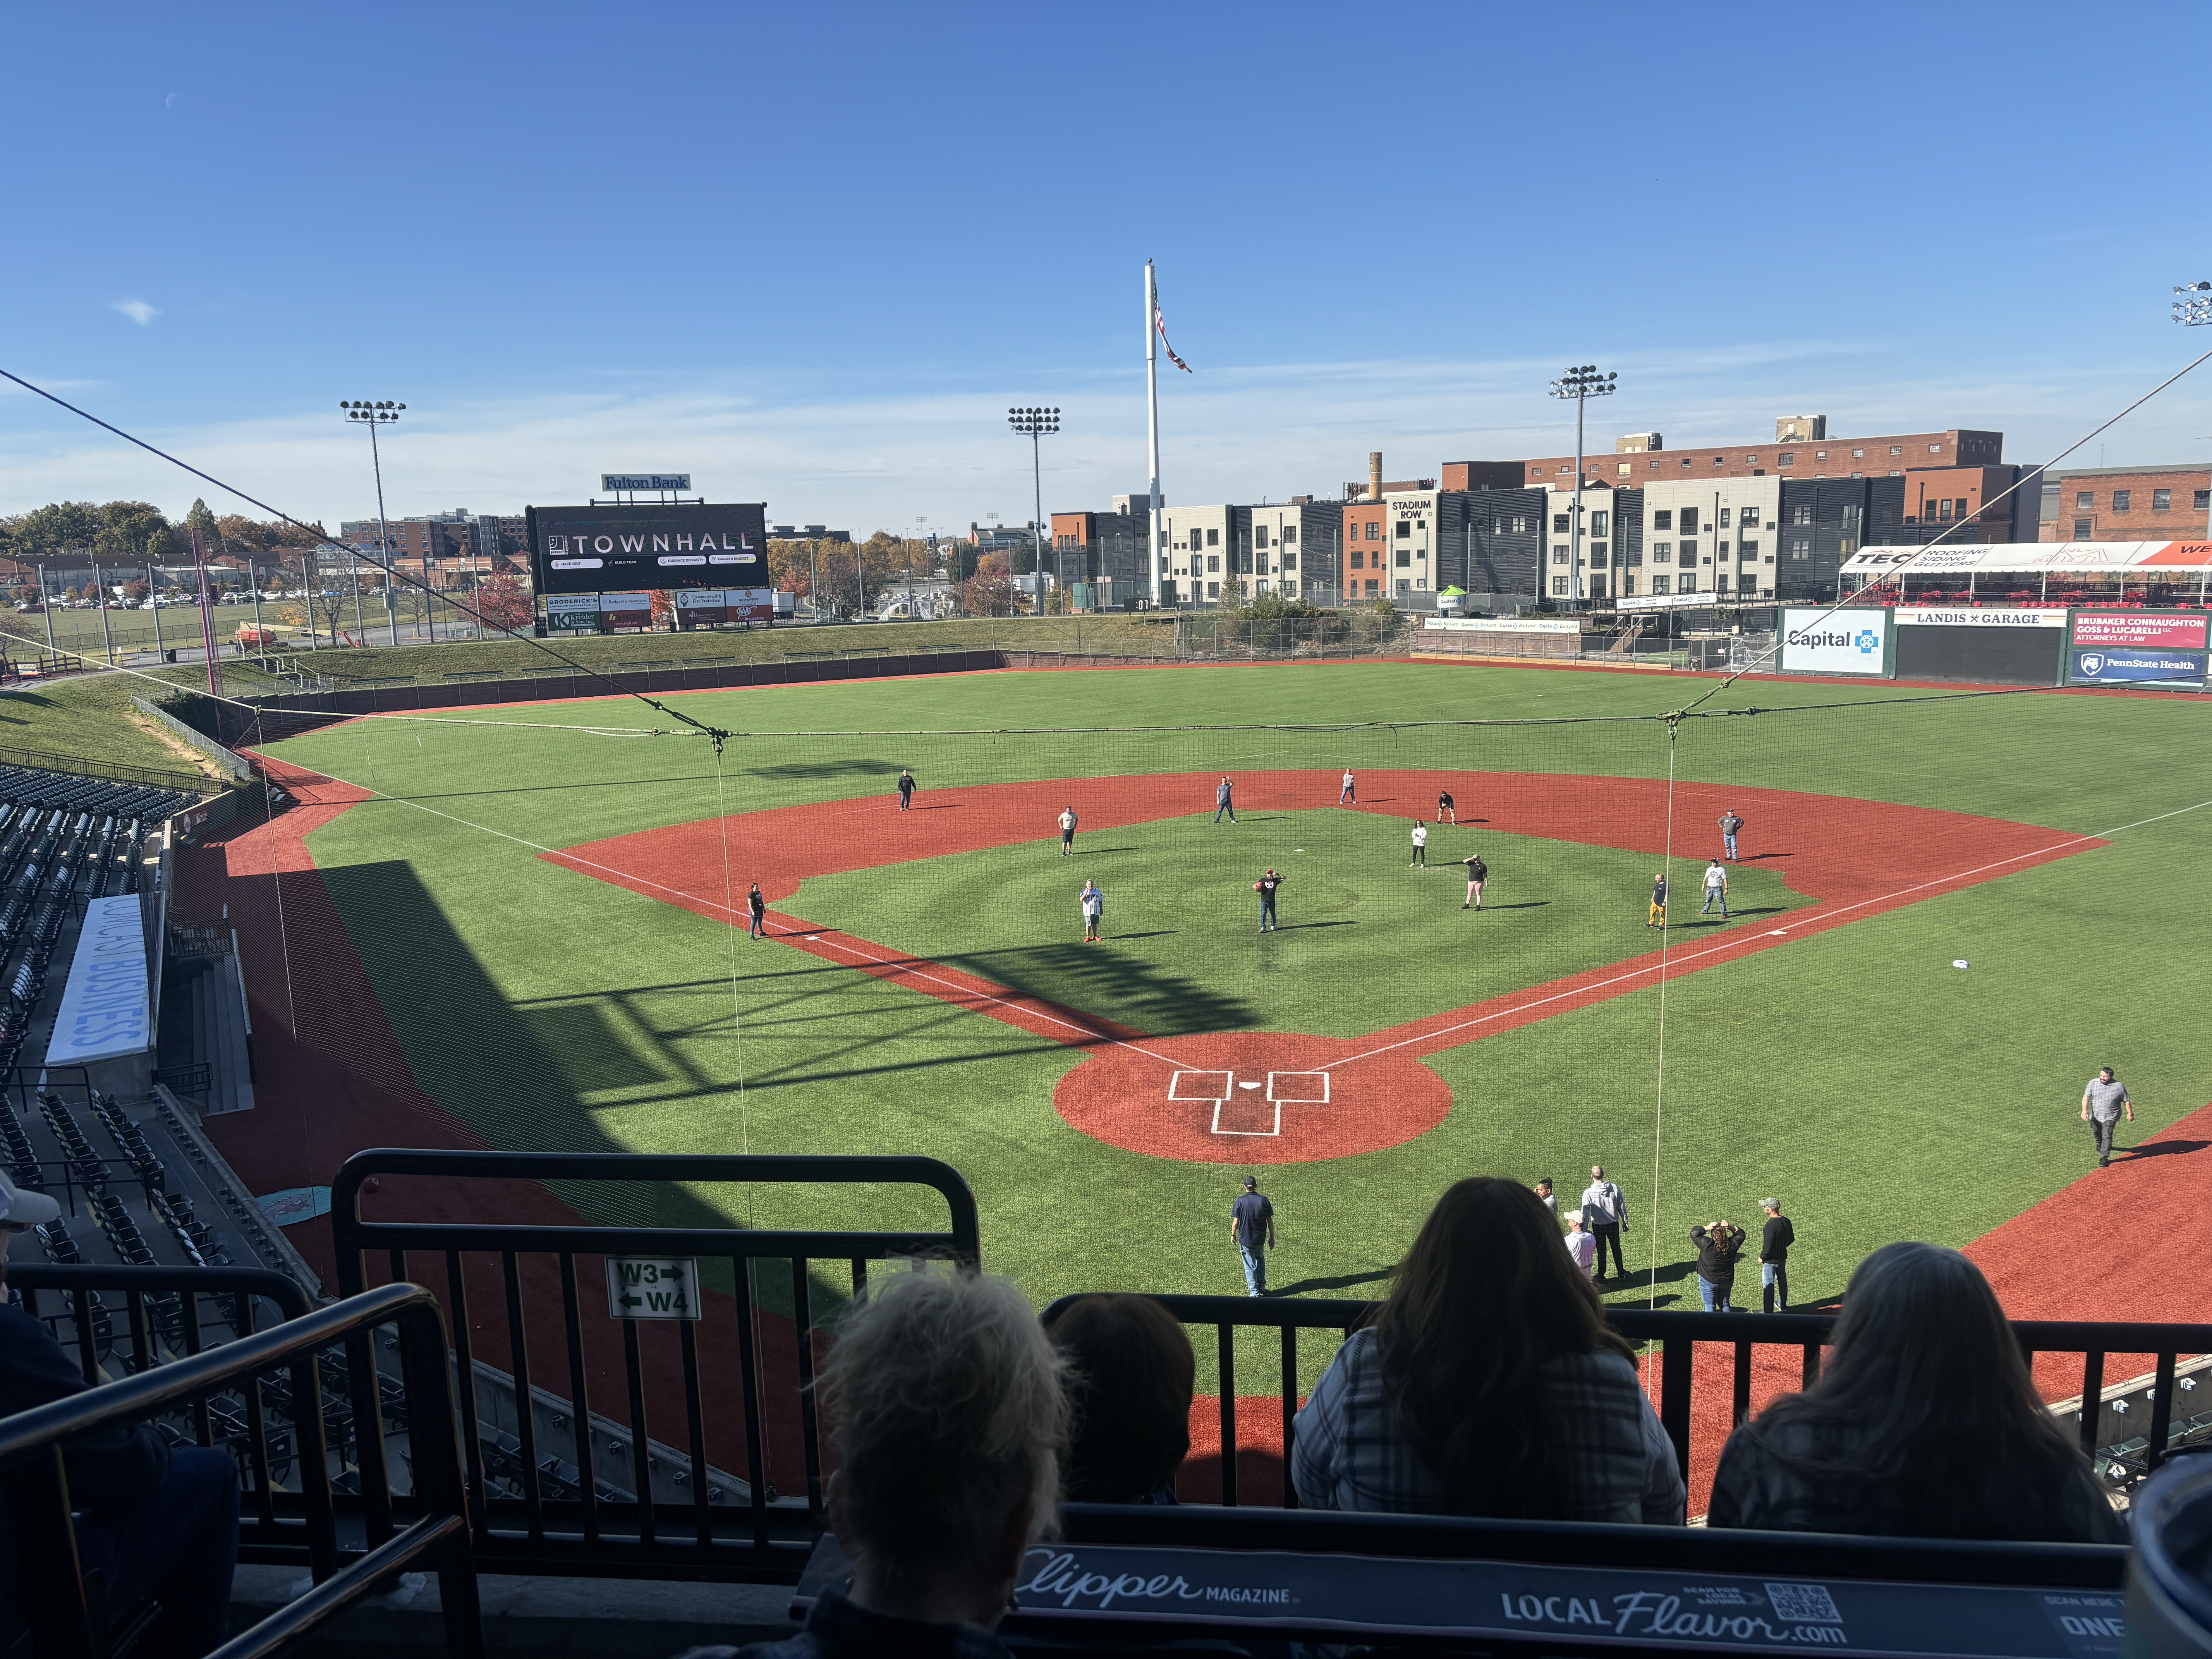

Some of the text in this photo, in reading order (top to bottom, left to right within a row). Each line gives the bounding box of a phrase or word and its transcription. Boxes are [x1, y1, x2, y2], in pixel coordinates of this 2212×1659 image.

[605, 476, 689, 489] Fulton Bank
[1392, 500, 1431, 510] STADIUM
[1401, 510, 1422, 519] ROW
[572, 532, 754, 554] TOWNHALL
[1856, 554, 1913, 564] TEC
[1917, 613, 2040, 623] LANDIS GARAGE
[2077, 617, 2204, 627] BRUBAKER CONNAUGHTON
[1788, 630, 1850, 649] Capital
[2160, 661, 2195, 670] Health
[71, 958, 147, 1046] BUSINESS
[616, 1262, 658, 1284] W3
[646, 1291, 688, 1312] W4
[1206, 1586, 1290, 1603] MAGAZINE
[2044, 1595, 2081, 1605] SCAN
[2060, 1615, 2126, 1638] ONE
